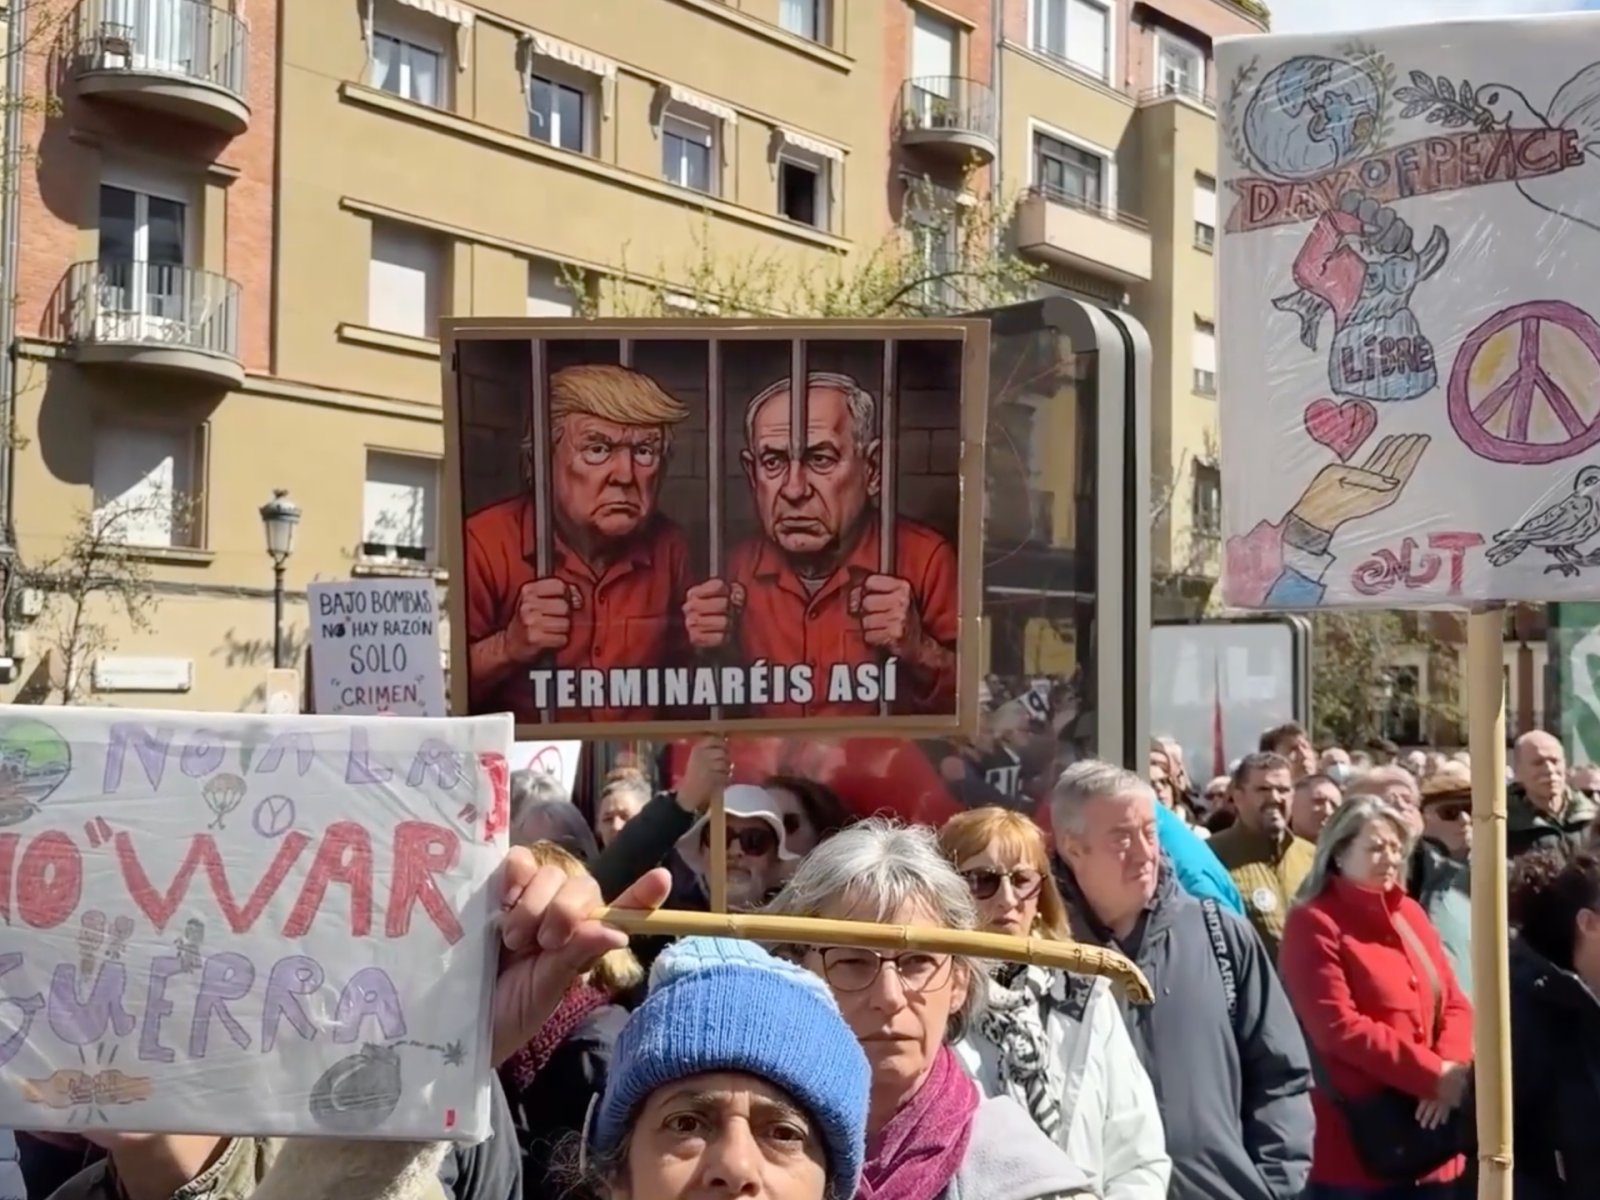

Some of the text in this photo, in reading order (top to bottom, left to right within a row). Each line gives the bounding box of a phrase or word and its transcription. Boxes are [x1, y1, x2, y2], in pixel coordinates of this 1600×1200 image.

[1249, 129, 1585, 223] DAY OF PEACE
[319, 589, 432, 616] BAJO BOMBAS
[351, 621, 379, 637] HAY
[349, 642, 408, 675] SOLO
[340, 684, 418, 708] CRIMEN
[528, 656, 899, 709] TERMINARÉIS ASÍ
[103, 721, 226, 793] NO
[255, 731, 316, 776] A
[1202, 897, 1227, 955] UNDER
